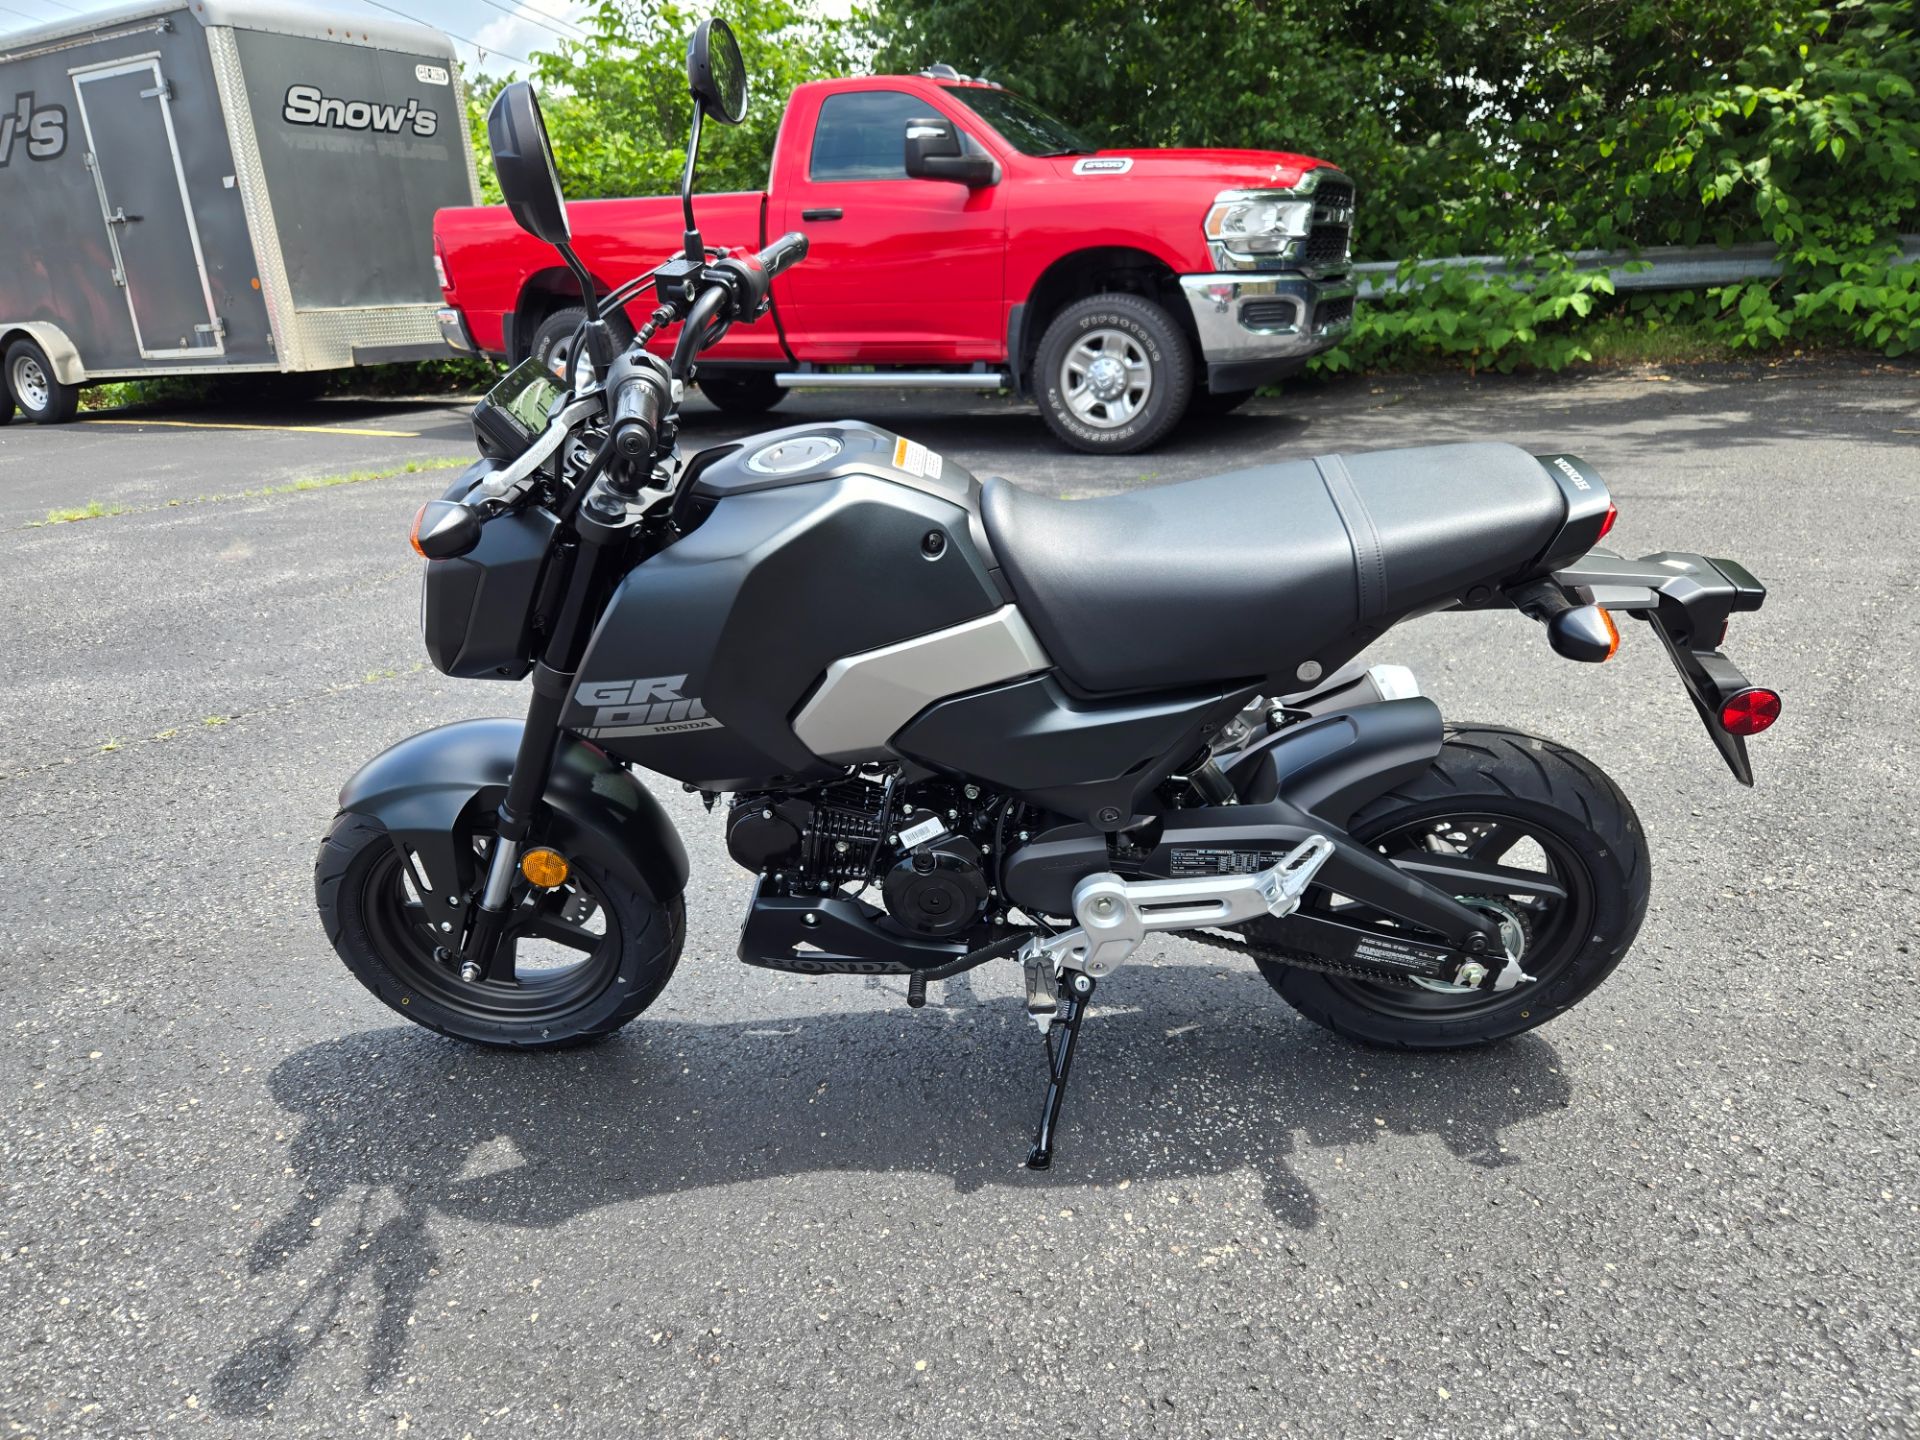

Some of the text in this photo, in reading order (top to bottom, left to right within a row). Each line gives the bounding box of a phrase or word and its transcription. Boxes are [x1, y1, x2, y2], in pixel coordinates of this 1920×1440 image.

[283, 84, 438, 136] Snow's
[1553, 457, 1592, 490] HONDA
[654, 721, 712, 733] HONDA
[760, 956, 915, 973] HONDA
